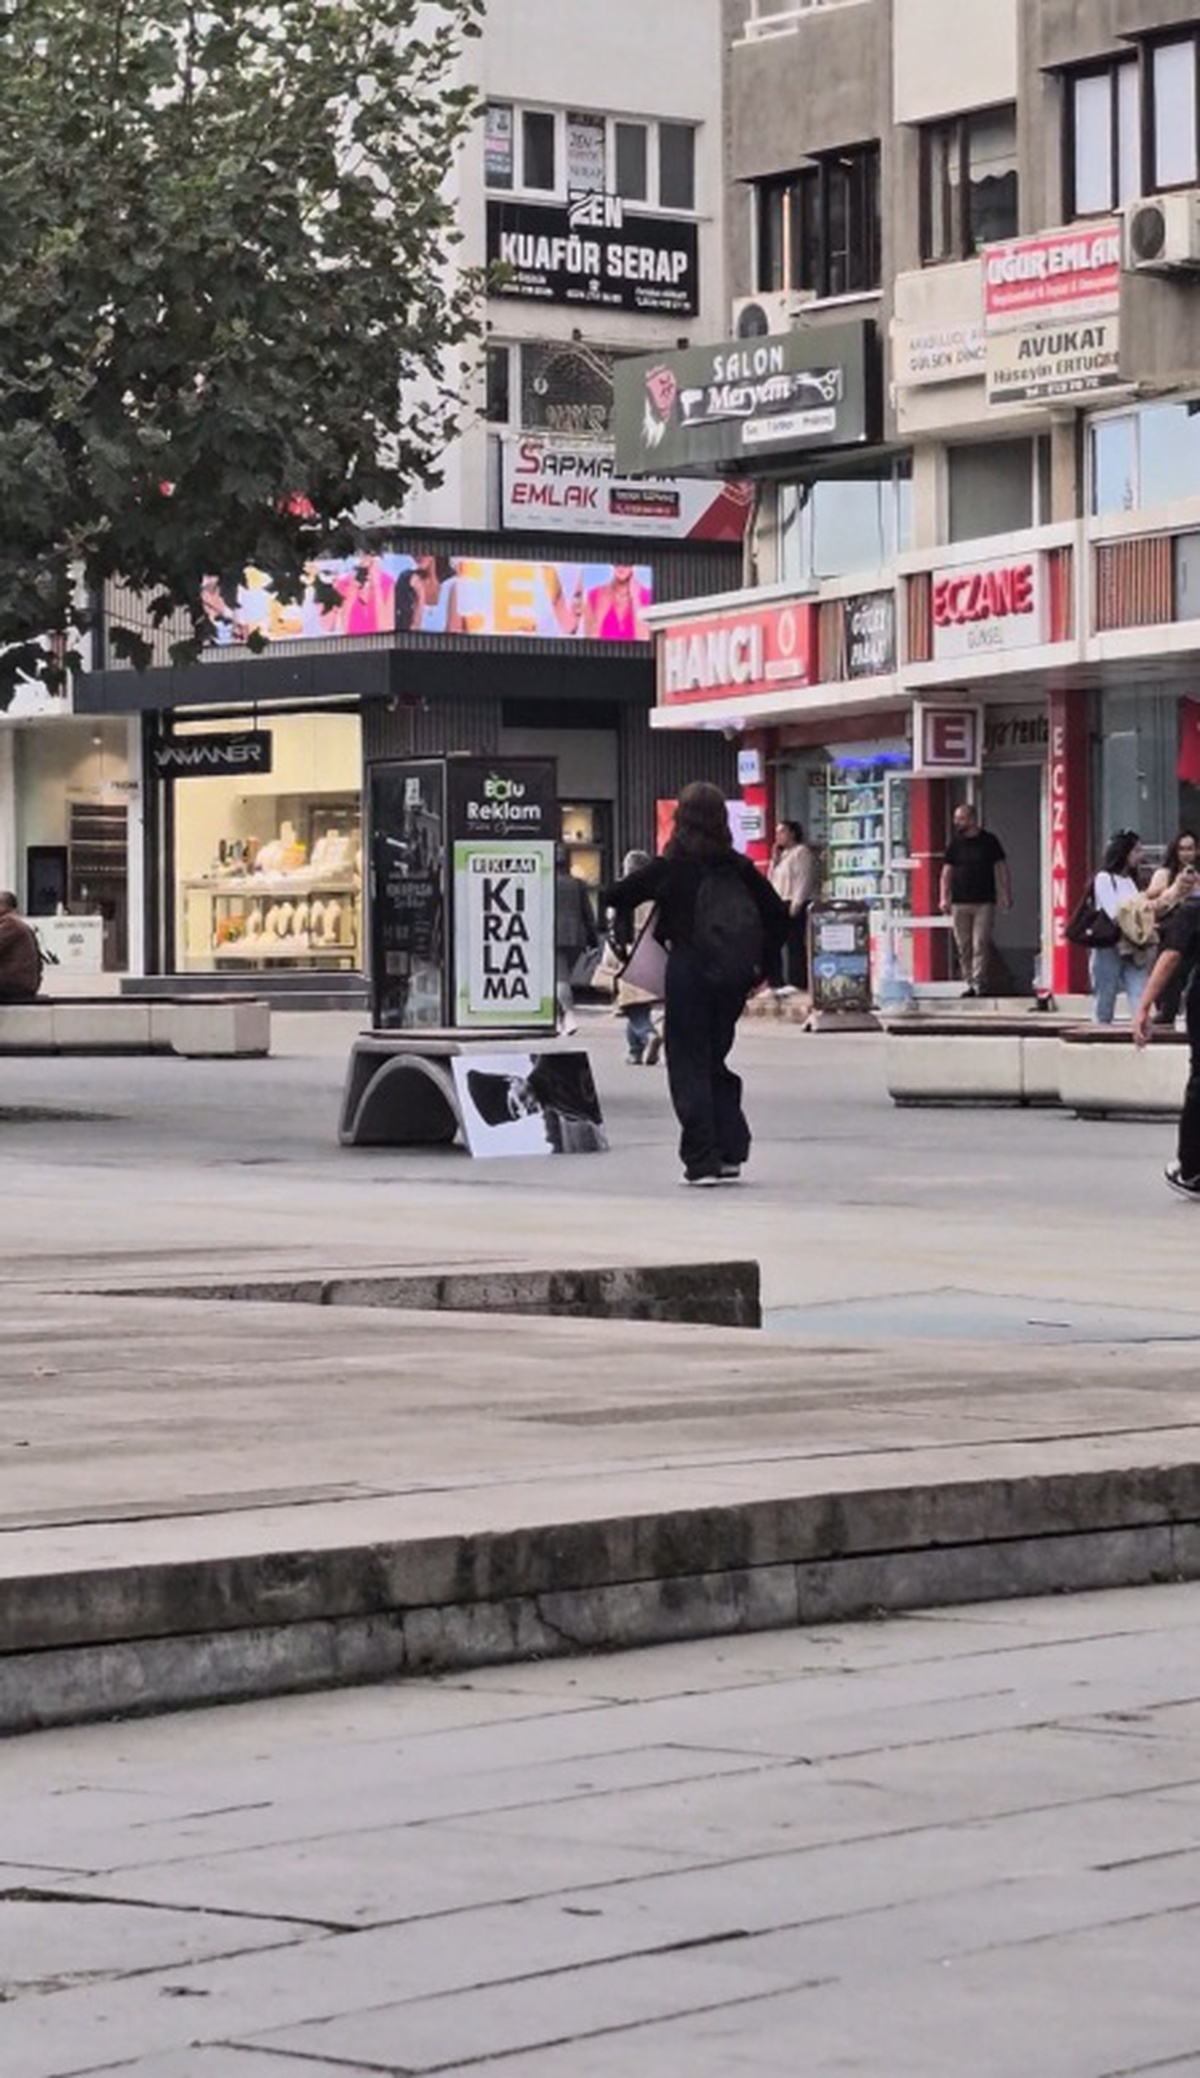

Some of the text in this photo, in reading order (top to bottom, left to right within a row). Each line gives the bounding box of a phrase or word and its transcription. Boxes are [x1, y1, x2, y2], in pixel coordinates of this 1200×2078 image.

[501, 231, 689, 284] KUAFÖR SERAP
[1018, 326, 1106, 361] AVUKAT
[713, 346, 784, 382] SALON
[706, 374, 791, 416] Meryem
[511, 482, 598, 509] EMLAK
[933, 563, 1034, 628] ECZANE
[666, 624, 763, 692] HANCI
[467, 801, 541, 820] Reklam
[1053, 727, 1065, 947] ECZANE
[472, 858, 536, 873] REKLAM
[483, 913, 529, 942] RA
[483, 944, 528, 975] LA
[483, 977, 529, 1000] MA
